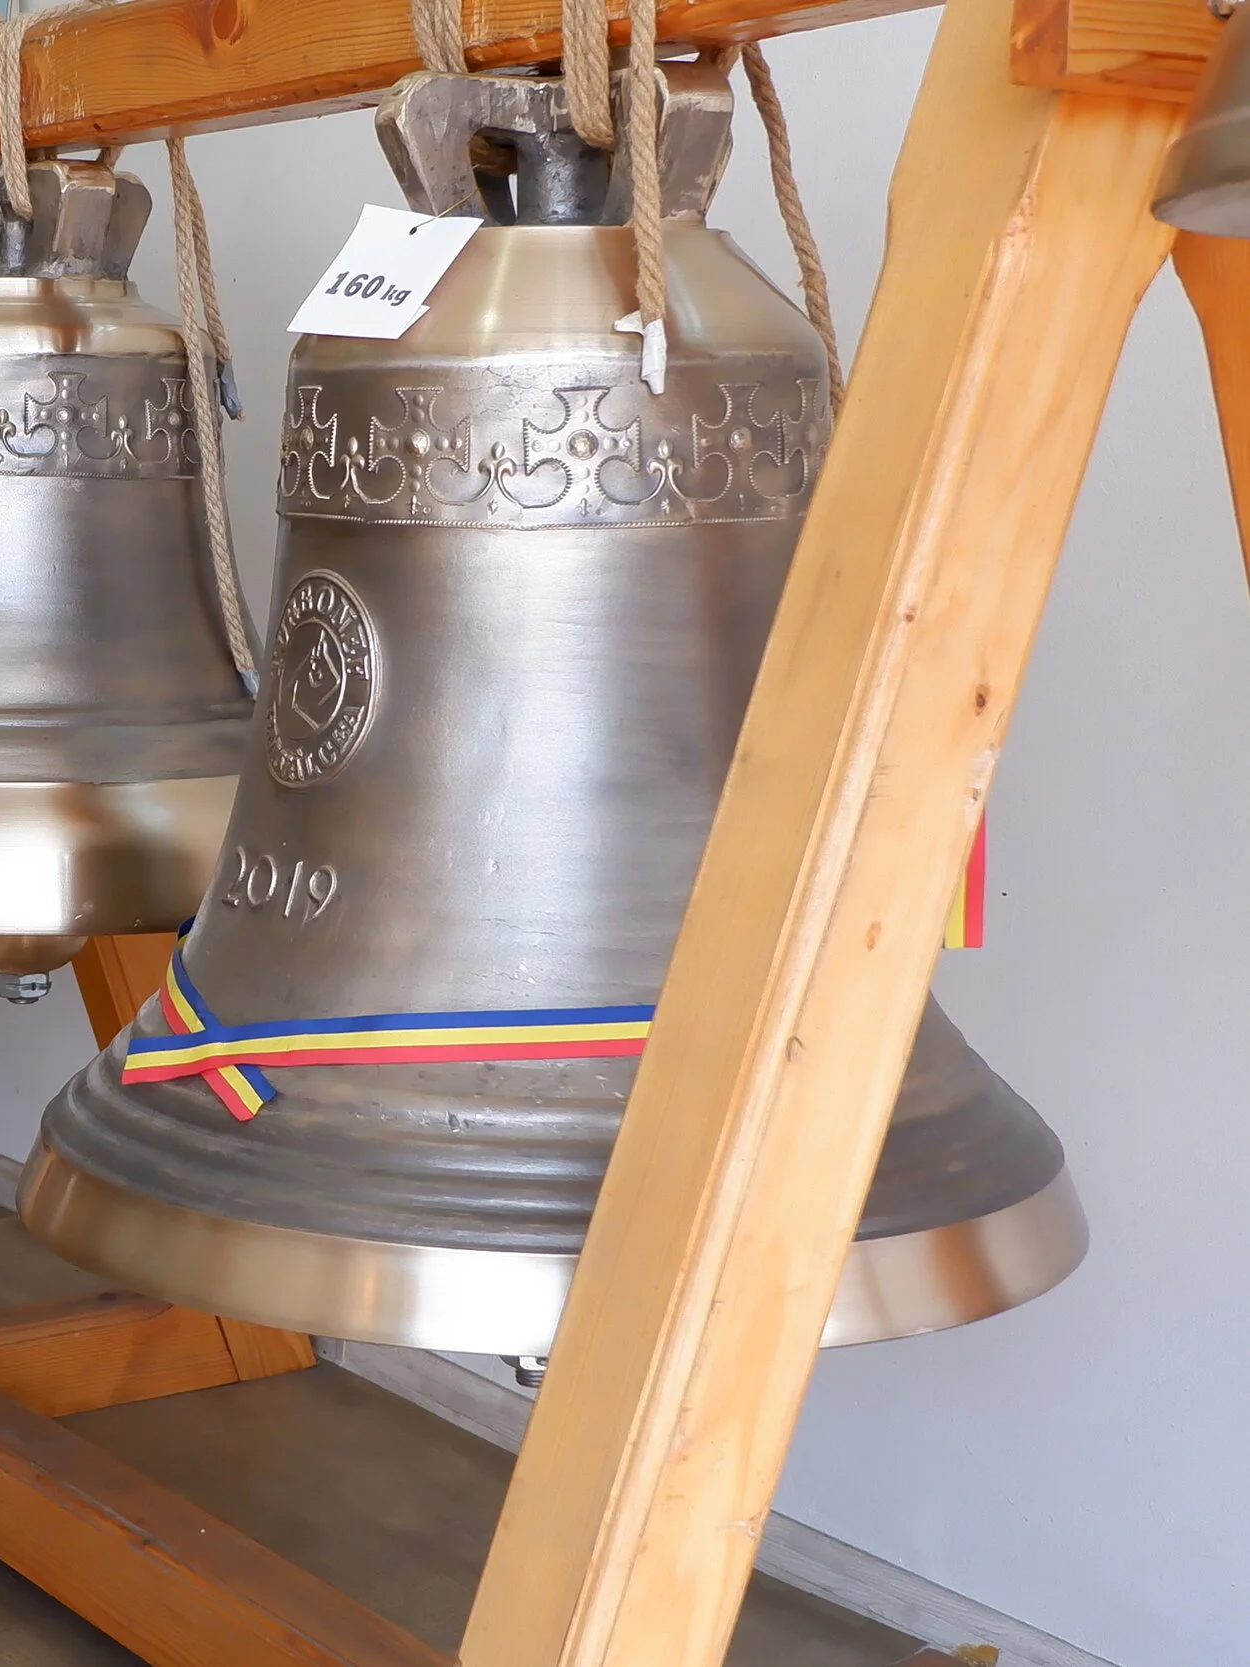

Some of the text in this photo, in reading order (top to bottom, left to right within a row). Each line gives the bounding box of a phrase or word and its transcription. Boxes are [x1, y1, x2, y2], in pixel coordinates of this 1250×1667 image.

[324, 271, 412, 307] 160 kg
[222, 845, 338, 926] 2019
